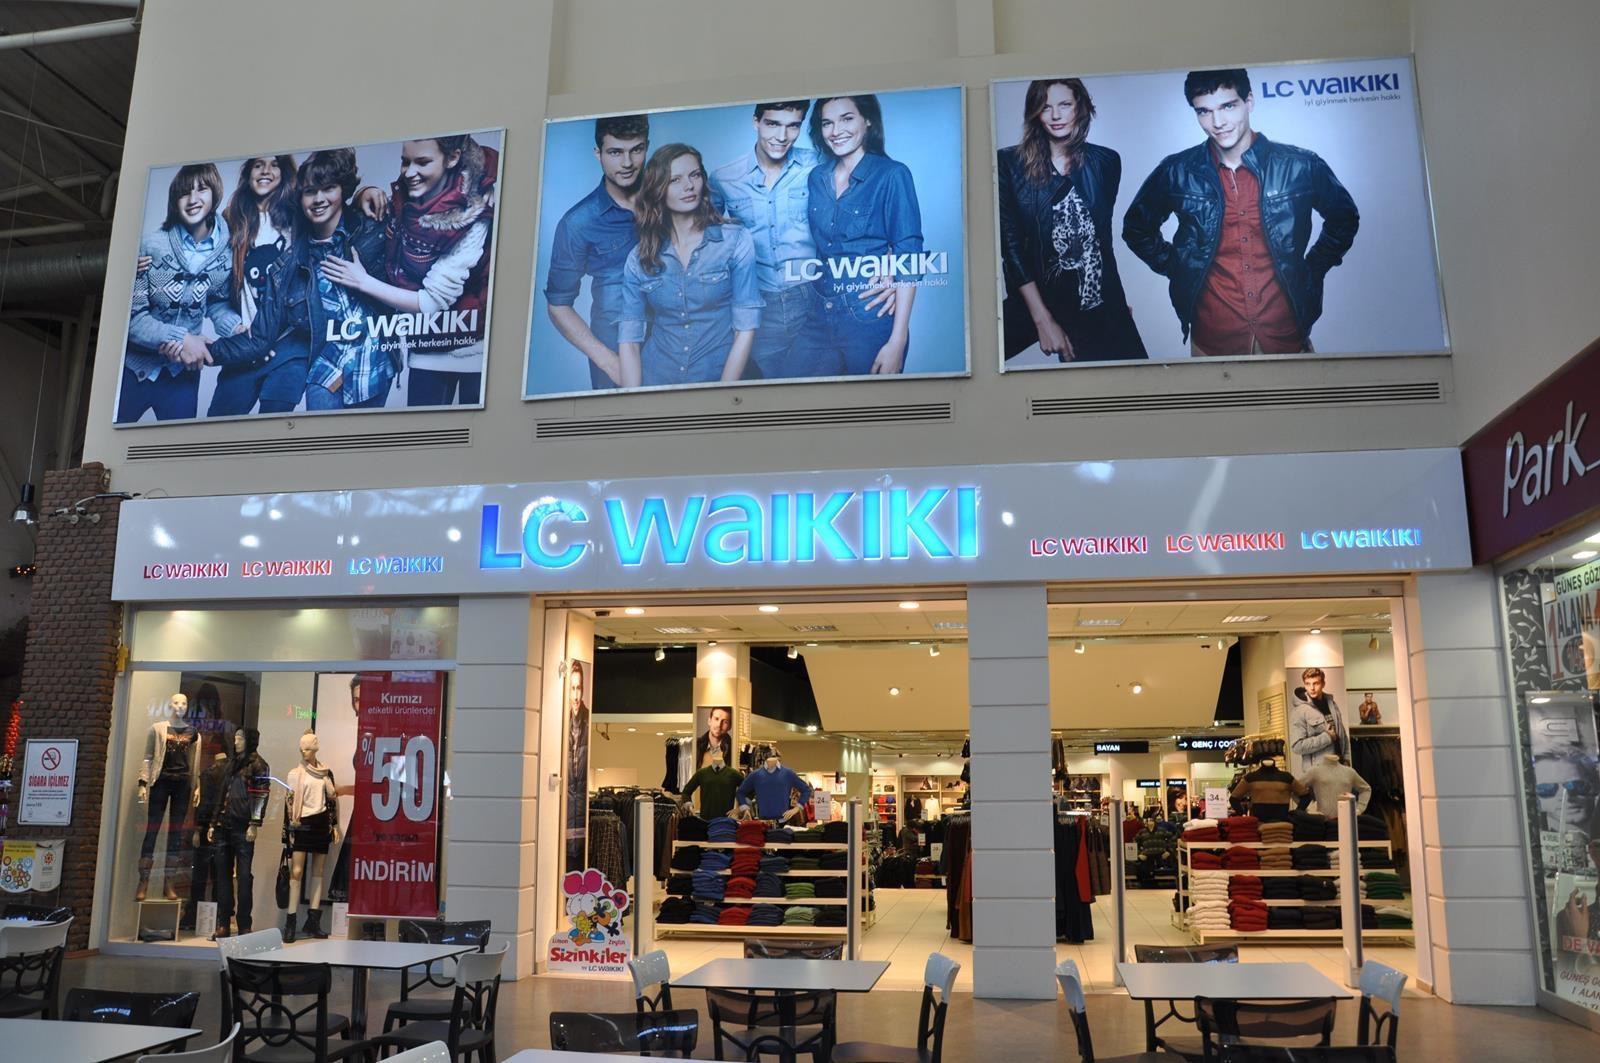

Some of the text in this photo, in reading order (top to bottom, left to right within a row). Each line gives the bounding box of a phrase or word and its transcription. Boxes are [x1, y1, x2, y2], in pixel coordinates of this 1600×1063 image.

[1261, 80, 1294, 99] LC
[784, 258, 824, 282] LC
[326, 316, 362, 342] LC
[419, 338, 451, 348] herkesin
[454, 336, 475, 346] hakkı
[479, 496, 589, 570] LC
[1300, 530, 1329, 550] LC
[1030, 538, 1057, 556] LC
[1165, 534, 1193, 553] LC
[143, 563, 163, 580] LC
[241, 560, 263, 578] LC
[349, 557, 372, 575] LC
[1556, 575, 1582, 596] GÜNEŞ
[1558, 593, 1594, 639] ALANA
[381, 692, 422, 704] Kırmızı
[368, 706, 393, 715] etiketli
[1096, 744, 1120, 752] BAYAN
[1191, 741, 1213, 750] GENÇ
[29, 773, 69, 789] SİGARA İÇİLMEZ
[354, 857, 434, 883] İNDİRİM
